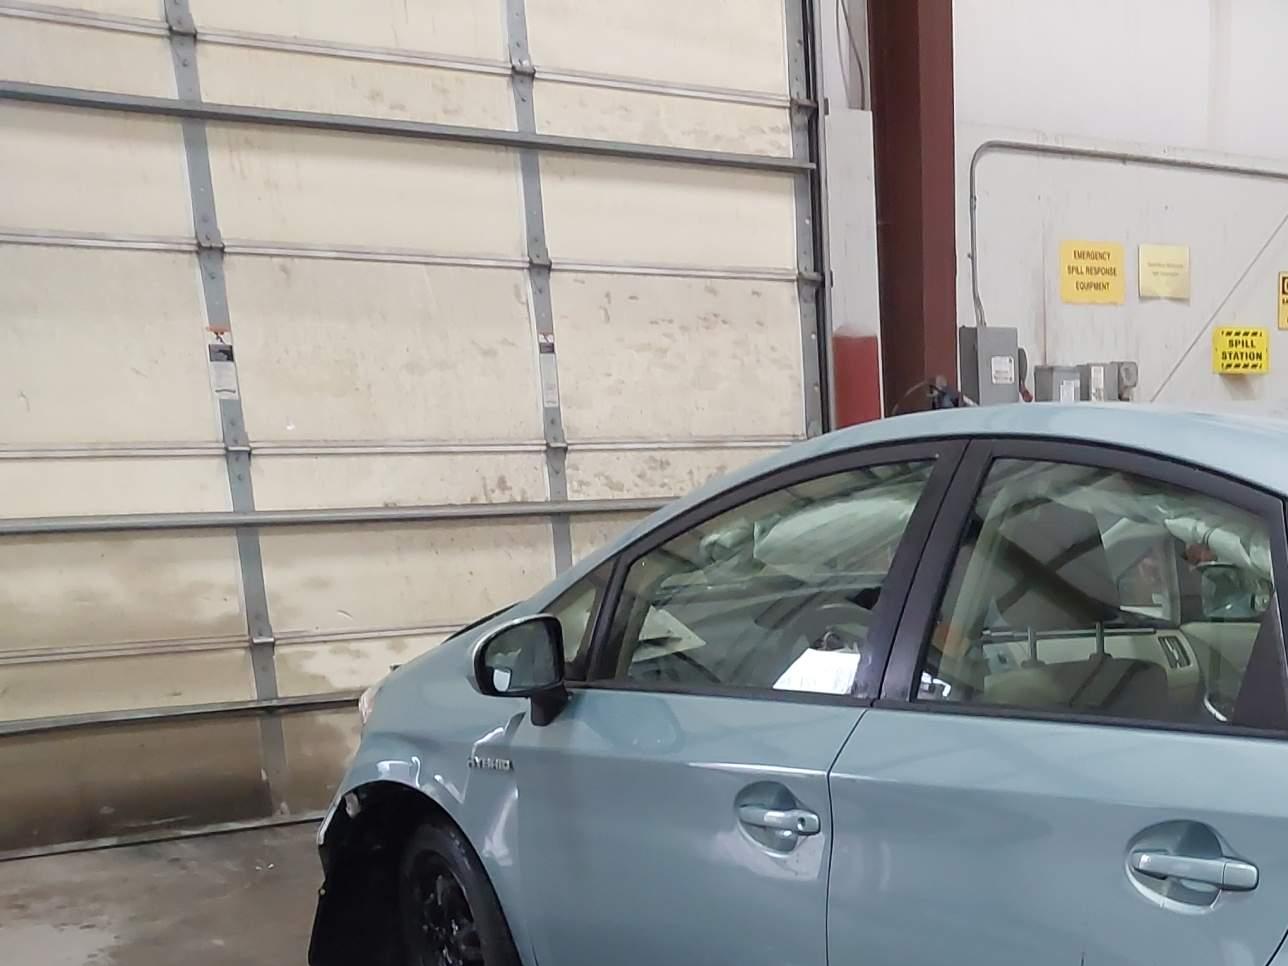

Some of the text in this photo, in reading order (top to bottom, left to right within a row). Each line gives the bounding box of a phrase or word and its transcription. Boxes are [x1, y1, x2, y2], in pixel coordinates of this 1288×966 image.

[1073, 250, 1111, 261] EMERGENCY
[1067, 265, 1117, 277] SPILL RESPONSE
[1075, 281, 1110, 291] EQUIPMENT
[1228, 339, 1256, 349] SPILL
[1221, 351, 1263, 361] STATION
